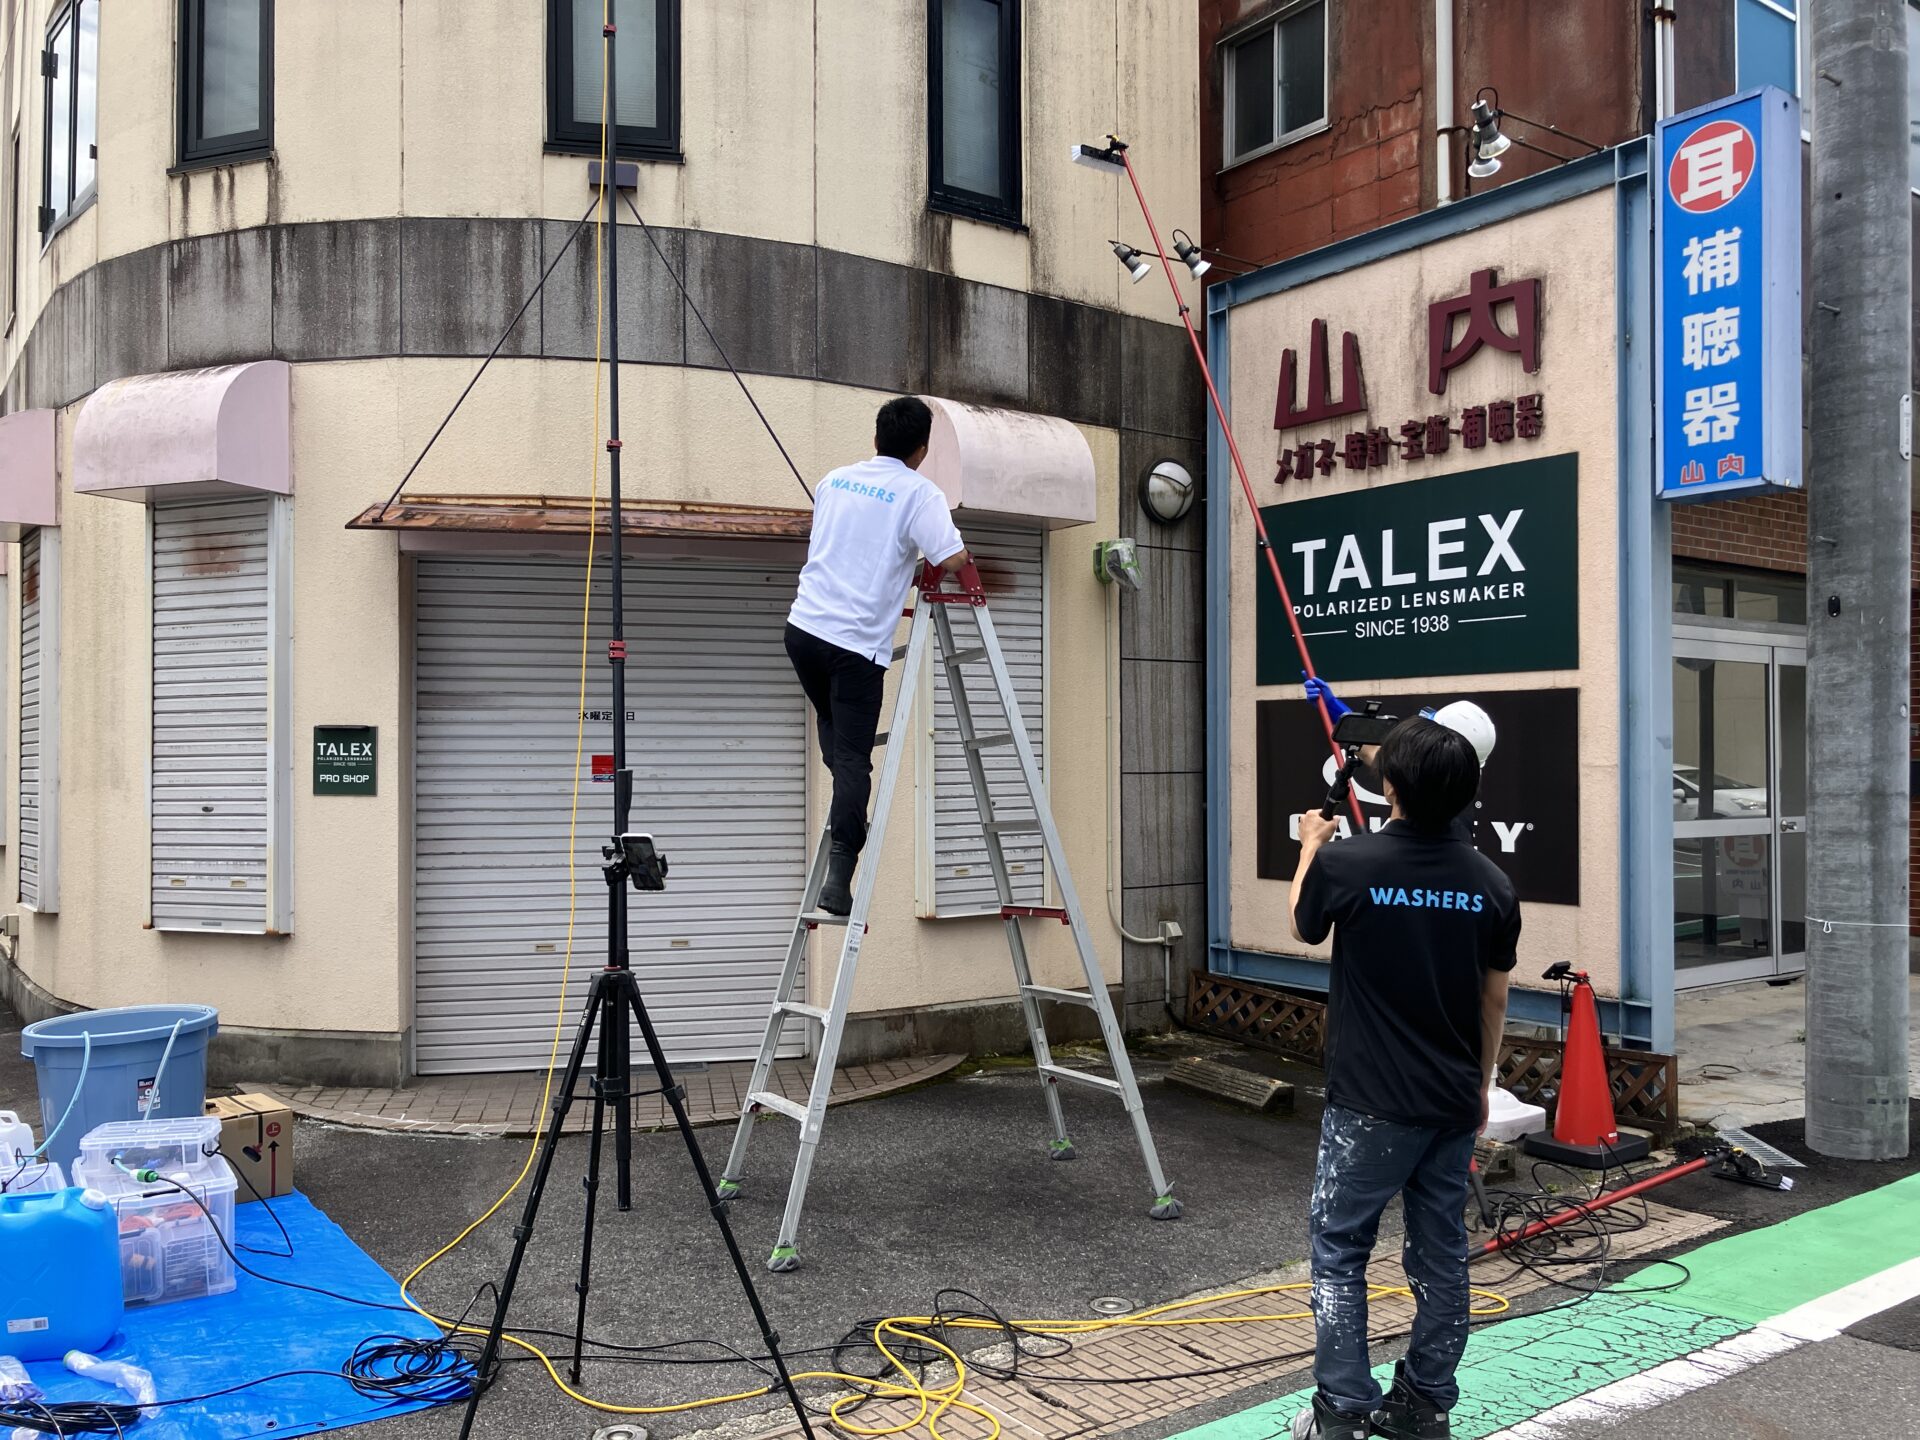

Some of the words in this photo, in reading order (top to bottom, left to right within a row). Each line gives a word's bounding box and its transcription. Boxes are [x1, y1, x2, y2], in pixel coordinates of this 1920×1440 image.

[1680, 129, 1743, 204] 耳
[1682, 226, 1742, 447] 補聴器
[1680, 454, 1744, 484] 山内
[1292, 508, 1526, 596] TALEX
[1293, 596, 1392, 619] POLARIZED
[1401, 582, 1526, 609] LENSMAKER
[1355, 618, 1405, 638] SINCE
[1411, 615, 1450, 634] 1938
[578, 711, 635, 721] 水曜定日
[317, 742, 372, 756] TALEX
[319, 774, 340, 783] PRO
[342, 774, 370, 783] SHOP
